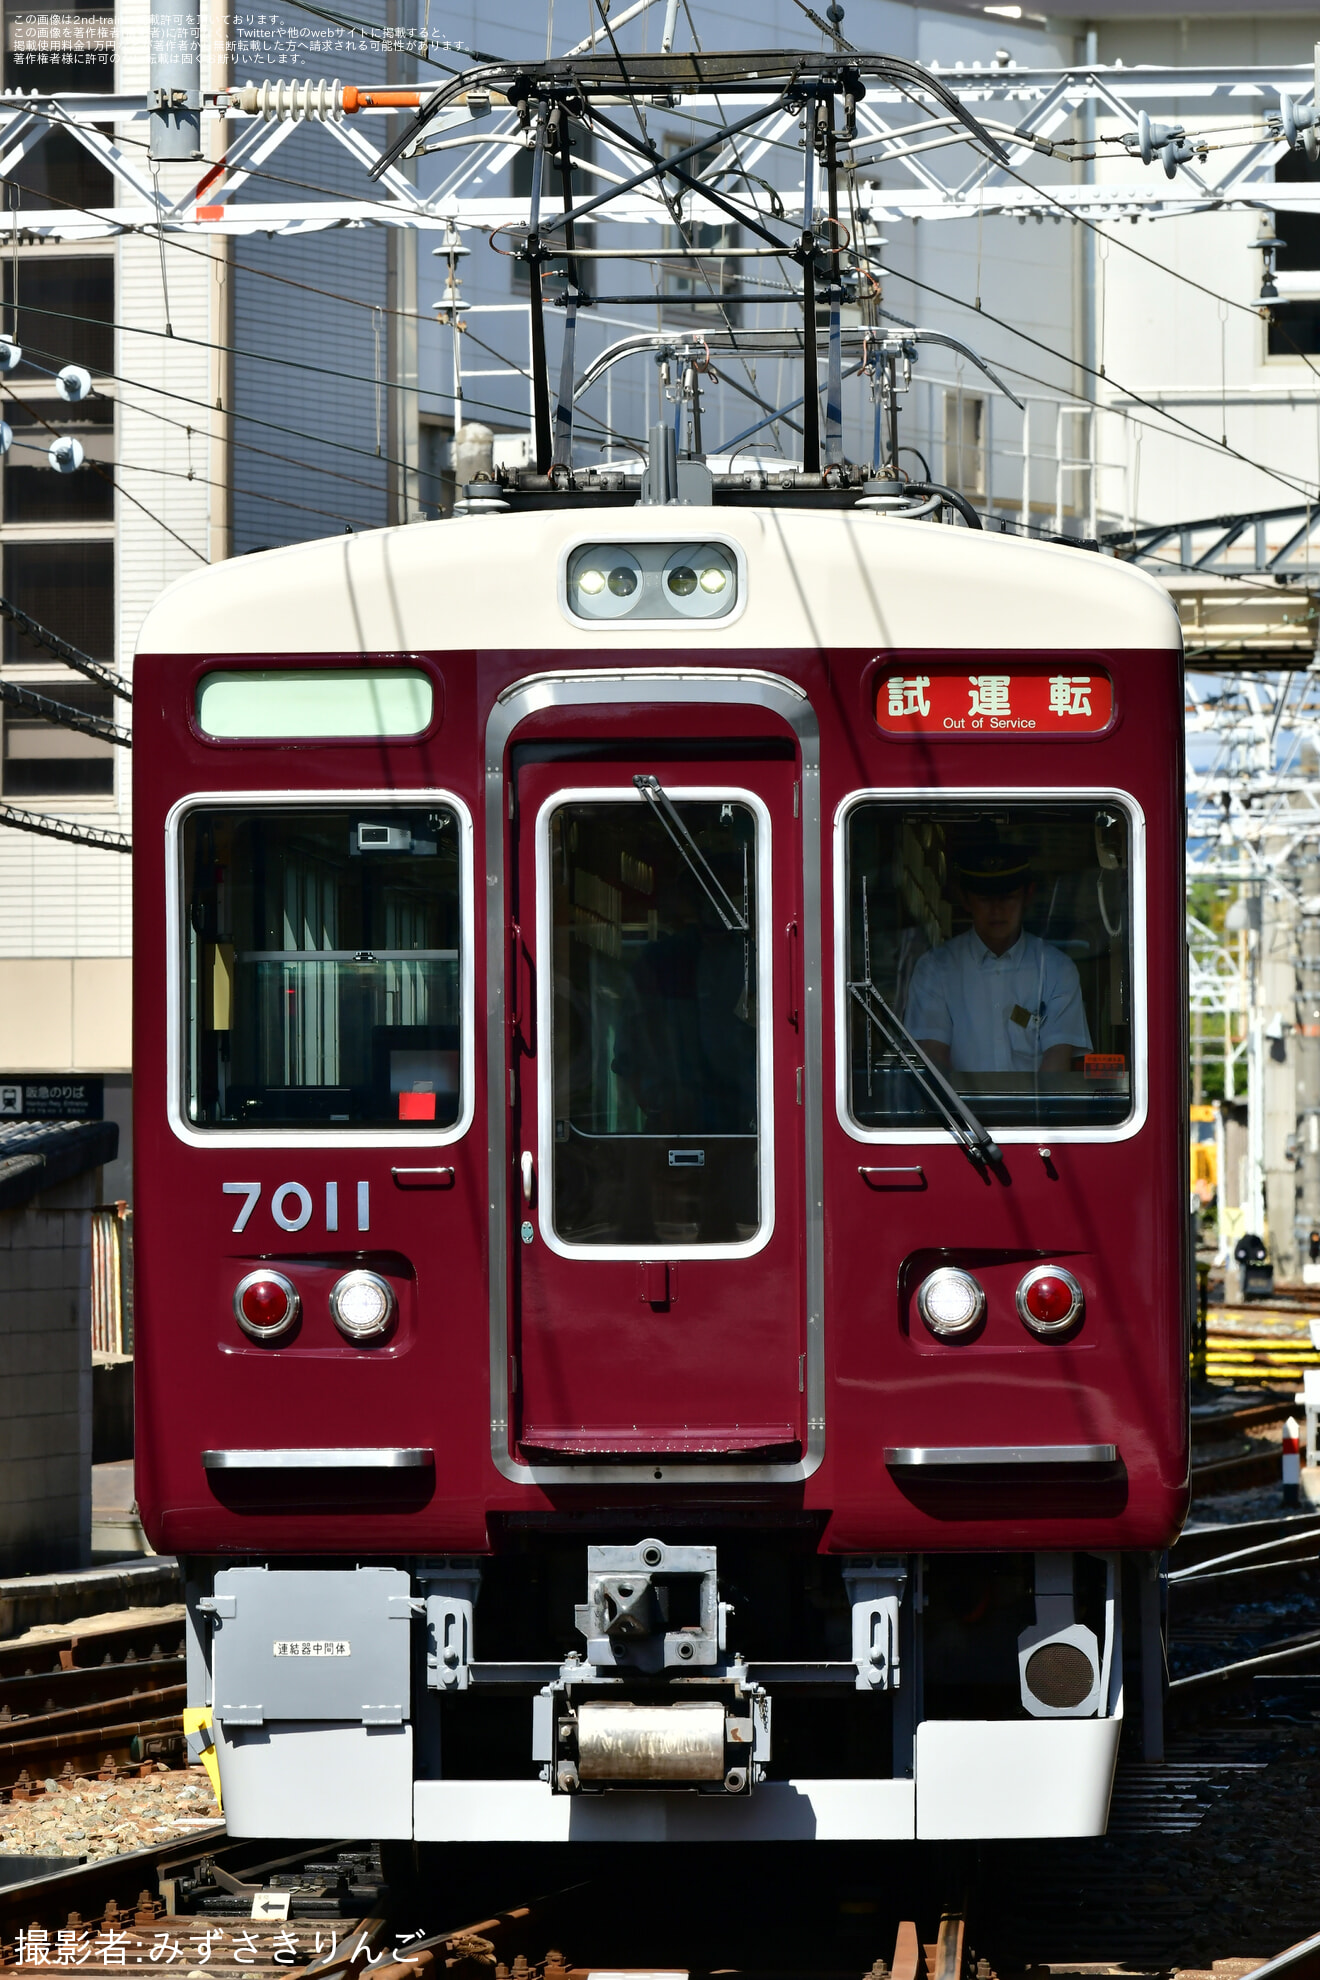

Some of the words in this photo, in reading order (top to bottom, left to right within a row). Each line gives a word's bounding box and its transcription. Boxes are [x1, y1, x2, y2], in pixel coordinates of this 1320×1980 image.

[887, 675, 1092, 717] 試運転
[943, 717, 966, 729] Out
[971, 717, 984, 729] of
[990, 717, 1037, 729] Service
[222, 1181, 370, 1233] 7011
[278, 1642, 346, 1656] 連結器中間体
